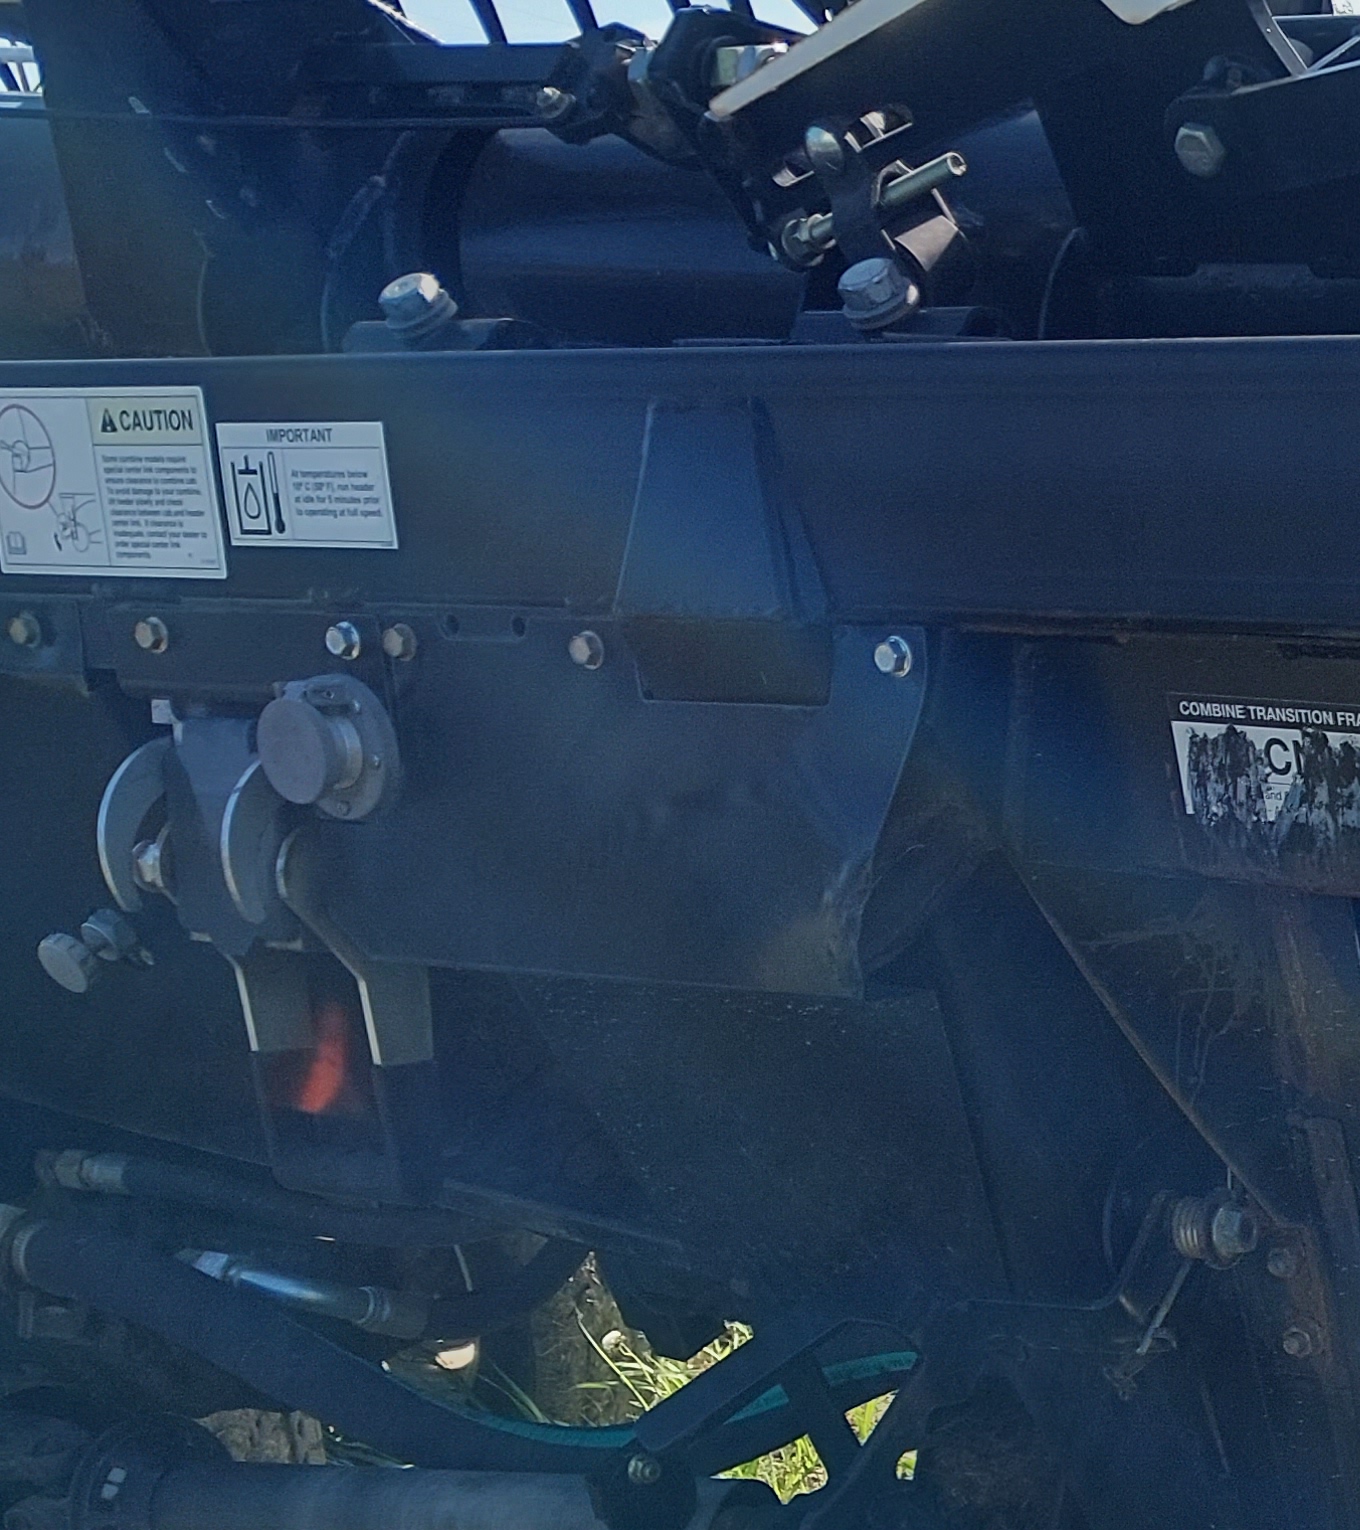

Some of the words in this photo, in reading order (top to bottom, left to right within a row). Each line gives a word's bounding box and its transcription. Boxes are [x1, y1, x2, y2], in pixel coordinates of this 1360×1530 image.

[119, 410, 193, 431] CAUTION
[266, 428, 332, 442] IMPORTANT
[1179, 701, 1246, 718] COMBINE
[1248, 705, 1335, 725] TRANSITION
